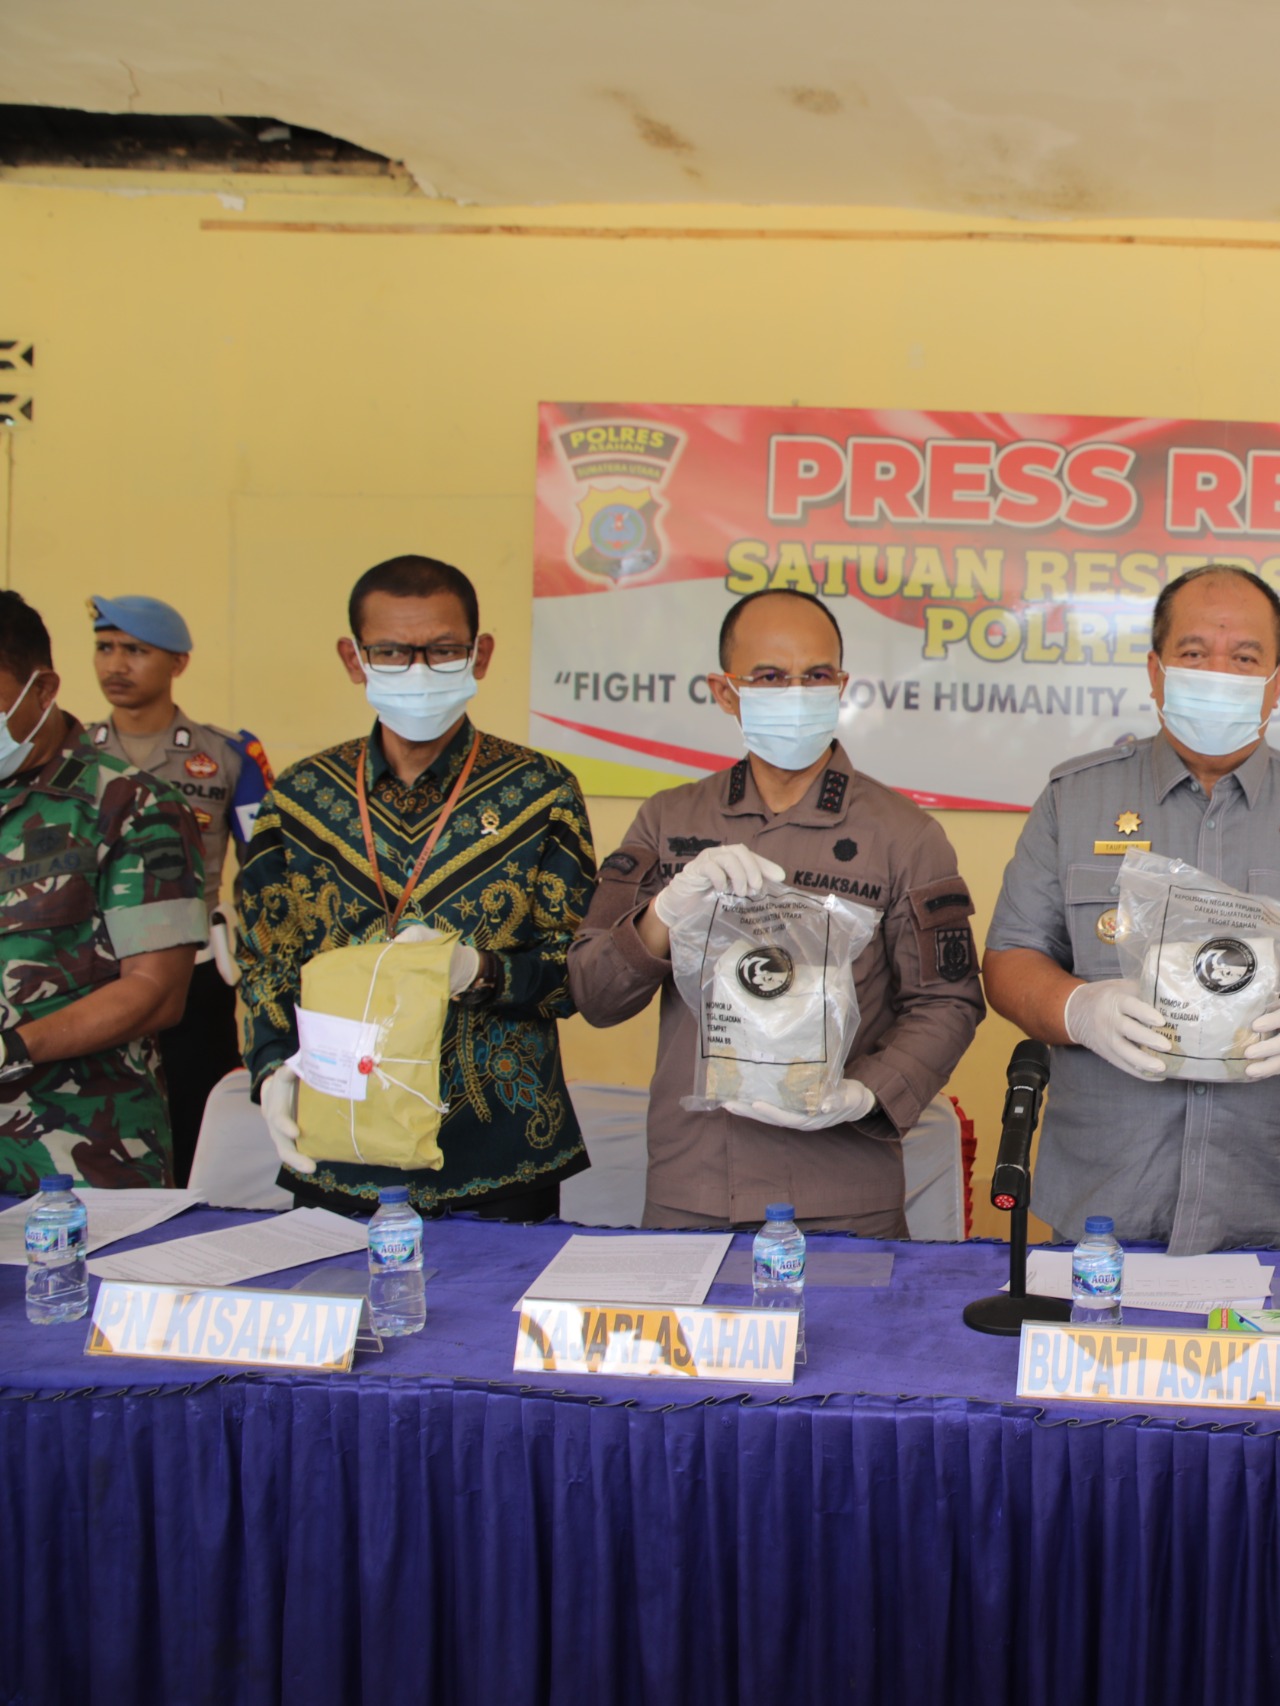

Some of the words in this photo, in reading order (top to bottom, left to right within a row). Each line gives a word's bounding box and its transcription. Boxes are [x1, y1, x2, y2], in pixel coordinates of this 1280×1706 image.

[570, 427, 665, 448] POLRES
[767, 434, 1140, 532] PRESS
[726, 540, 1004, 599] SATUAN
[922, 604, 1154, 665] POLRE
[842, 679, 920, 711] OVE
[934, 681, 1128, 717] HUMANITY
[7, 863, 41, 884] TNI
[793, 869, 882, 901] KEJAKSAAN
[1159, 997, 1182, 1009] NOMOR
[381, 1243, 407, 1254] AQUA
[1092, 1273, 1116, 1285] AQUA
[94, 1288, 159, 1352] PN
[163, 1293, 356, 1365] KISARAN
[523, 1308, 645, 1364] KAJARI
[655, 1314, 786, 1370] ASAHAN
[1027, 1332, 1148, 1397] BUPATI
